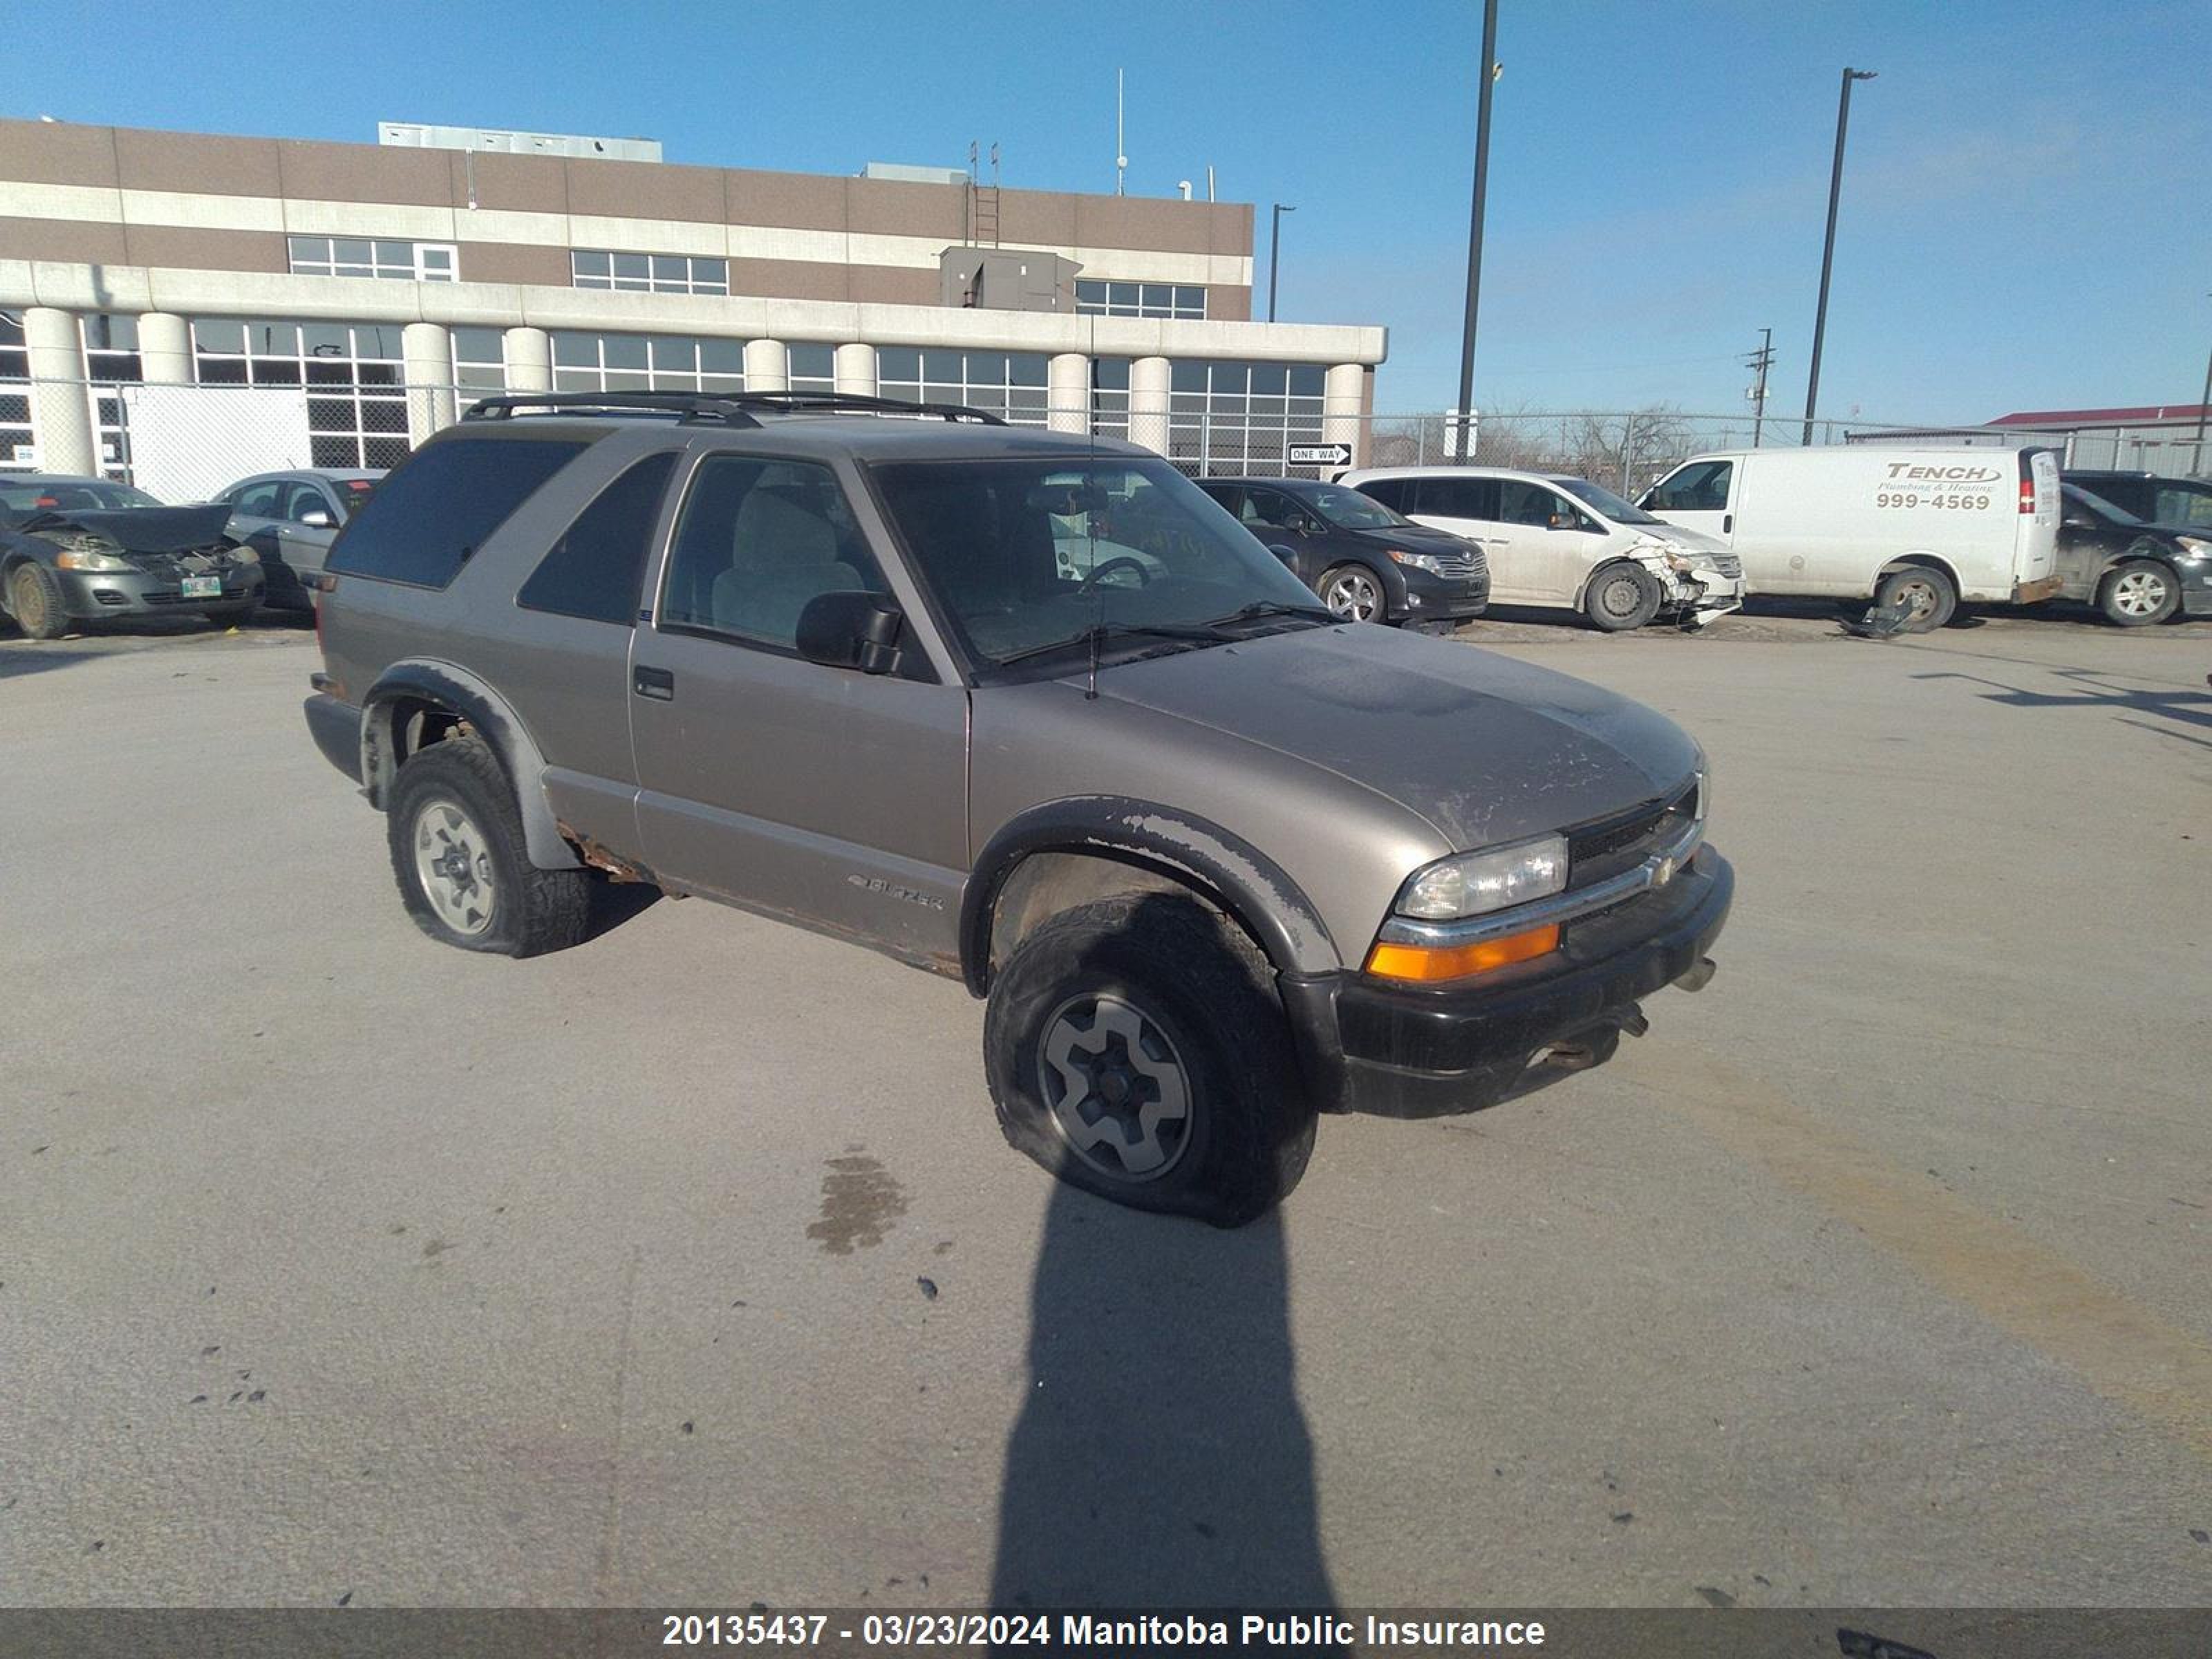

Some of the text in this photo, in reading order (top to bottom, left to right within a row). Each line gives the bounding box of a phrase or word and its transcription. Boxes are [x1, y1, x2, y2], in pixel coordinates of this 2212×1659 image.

[1293, 450, 1340, 459] ONE WAY
[1888, 462, 1989, 478] TENCH
[1878, 482, 1996, 493] Plumbing & Heating
[1877, 493, 1990, 509] 999-4569
